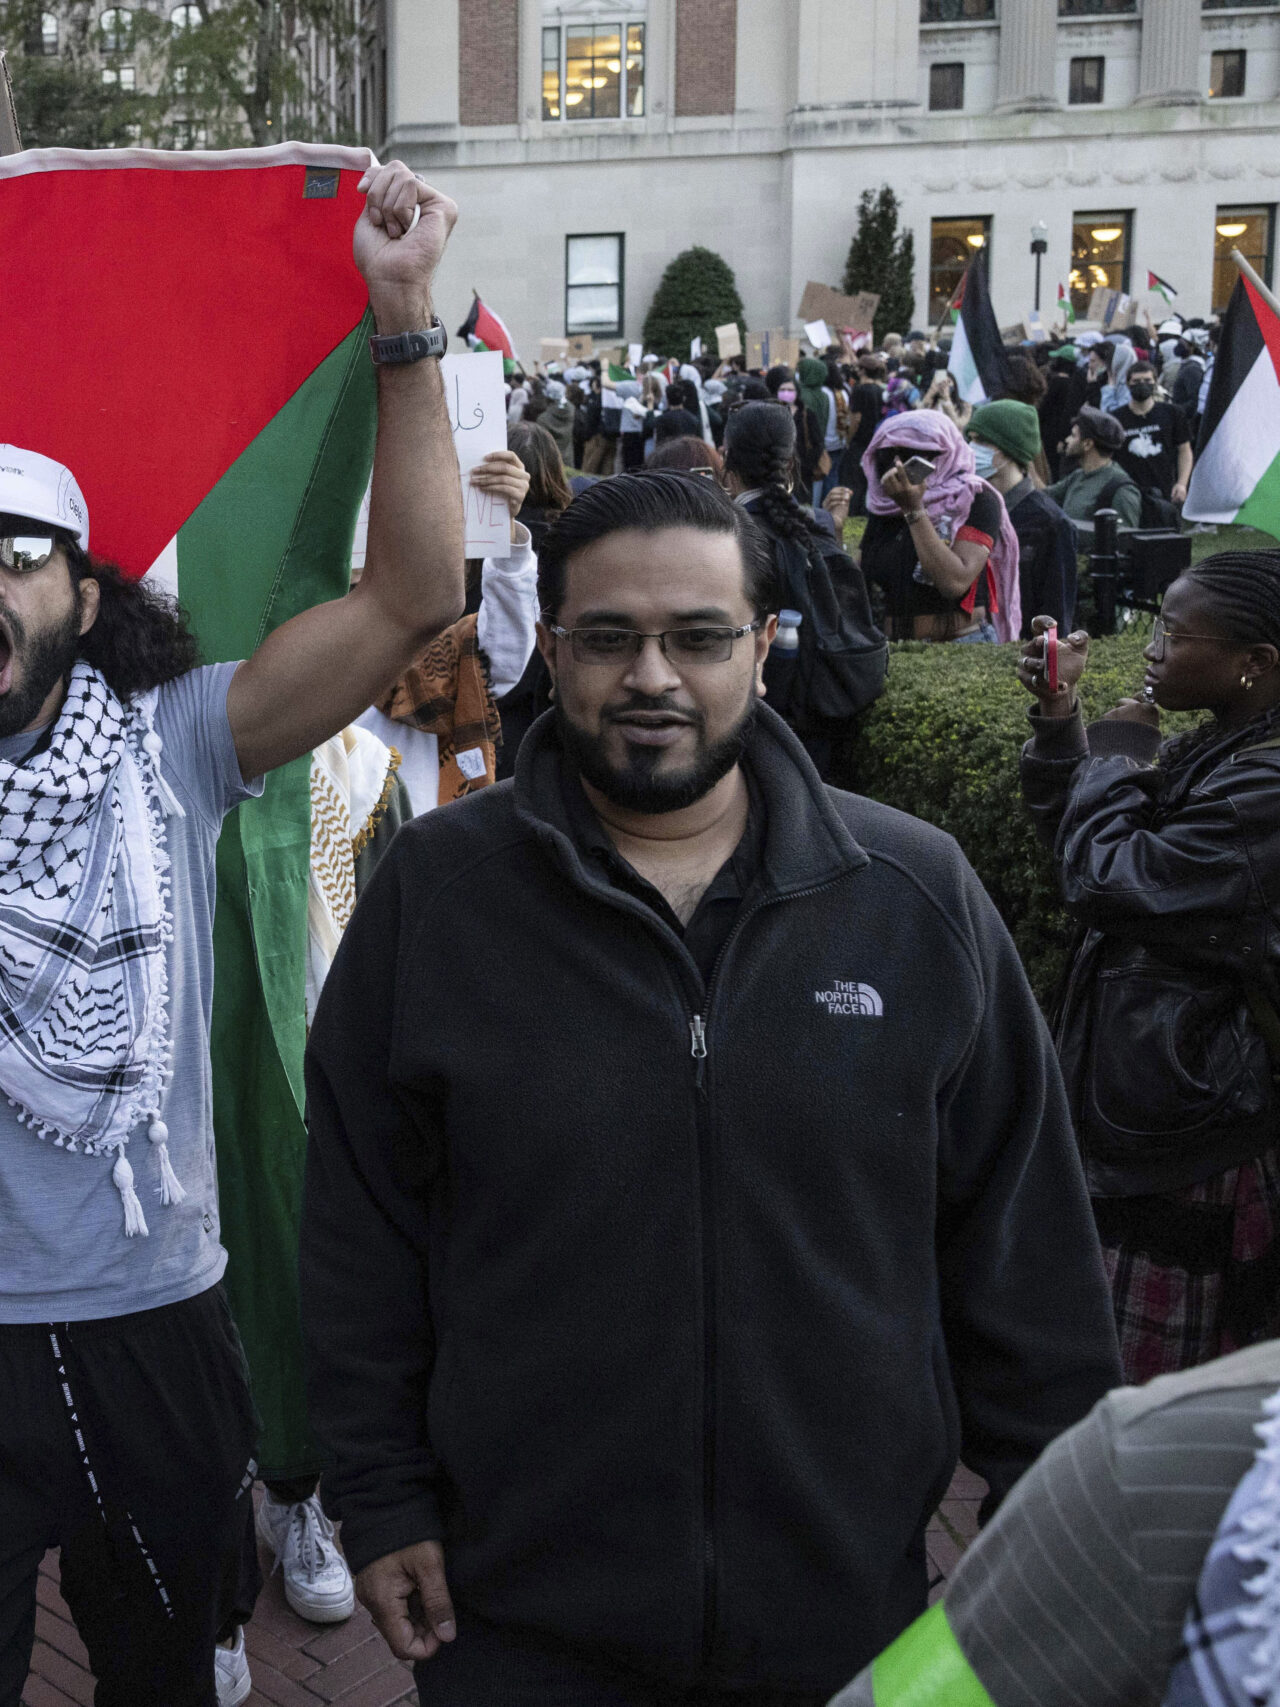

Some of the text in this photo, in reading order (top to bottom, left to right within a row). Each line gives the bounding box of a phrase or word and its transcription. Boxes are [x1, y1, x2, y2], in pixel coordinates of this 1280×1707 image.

[833, 980, 857, 993] THE
[814, 991, 859, 1003] NORTH
[828, 1003, 860, 1015] FACE
